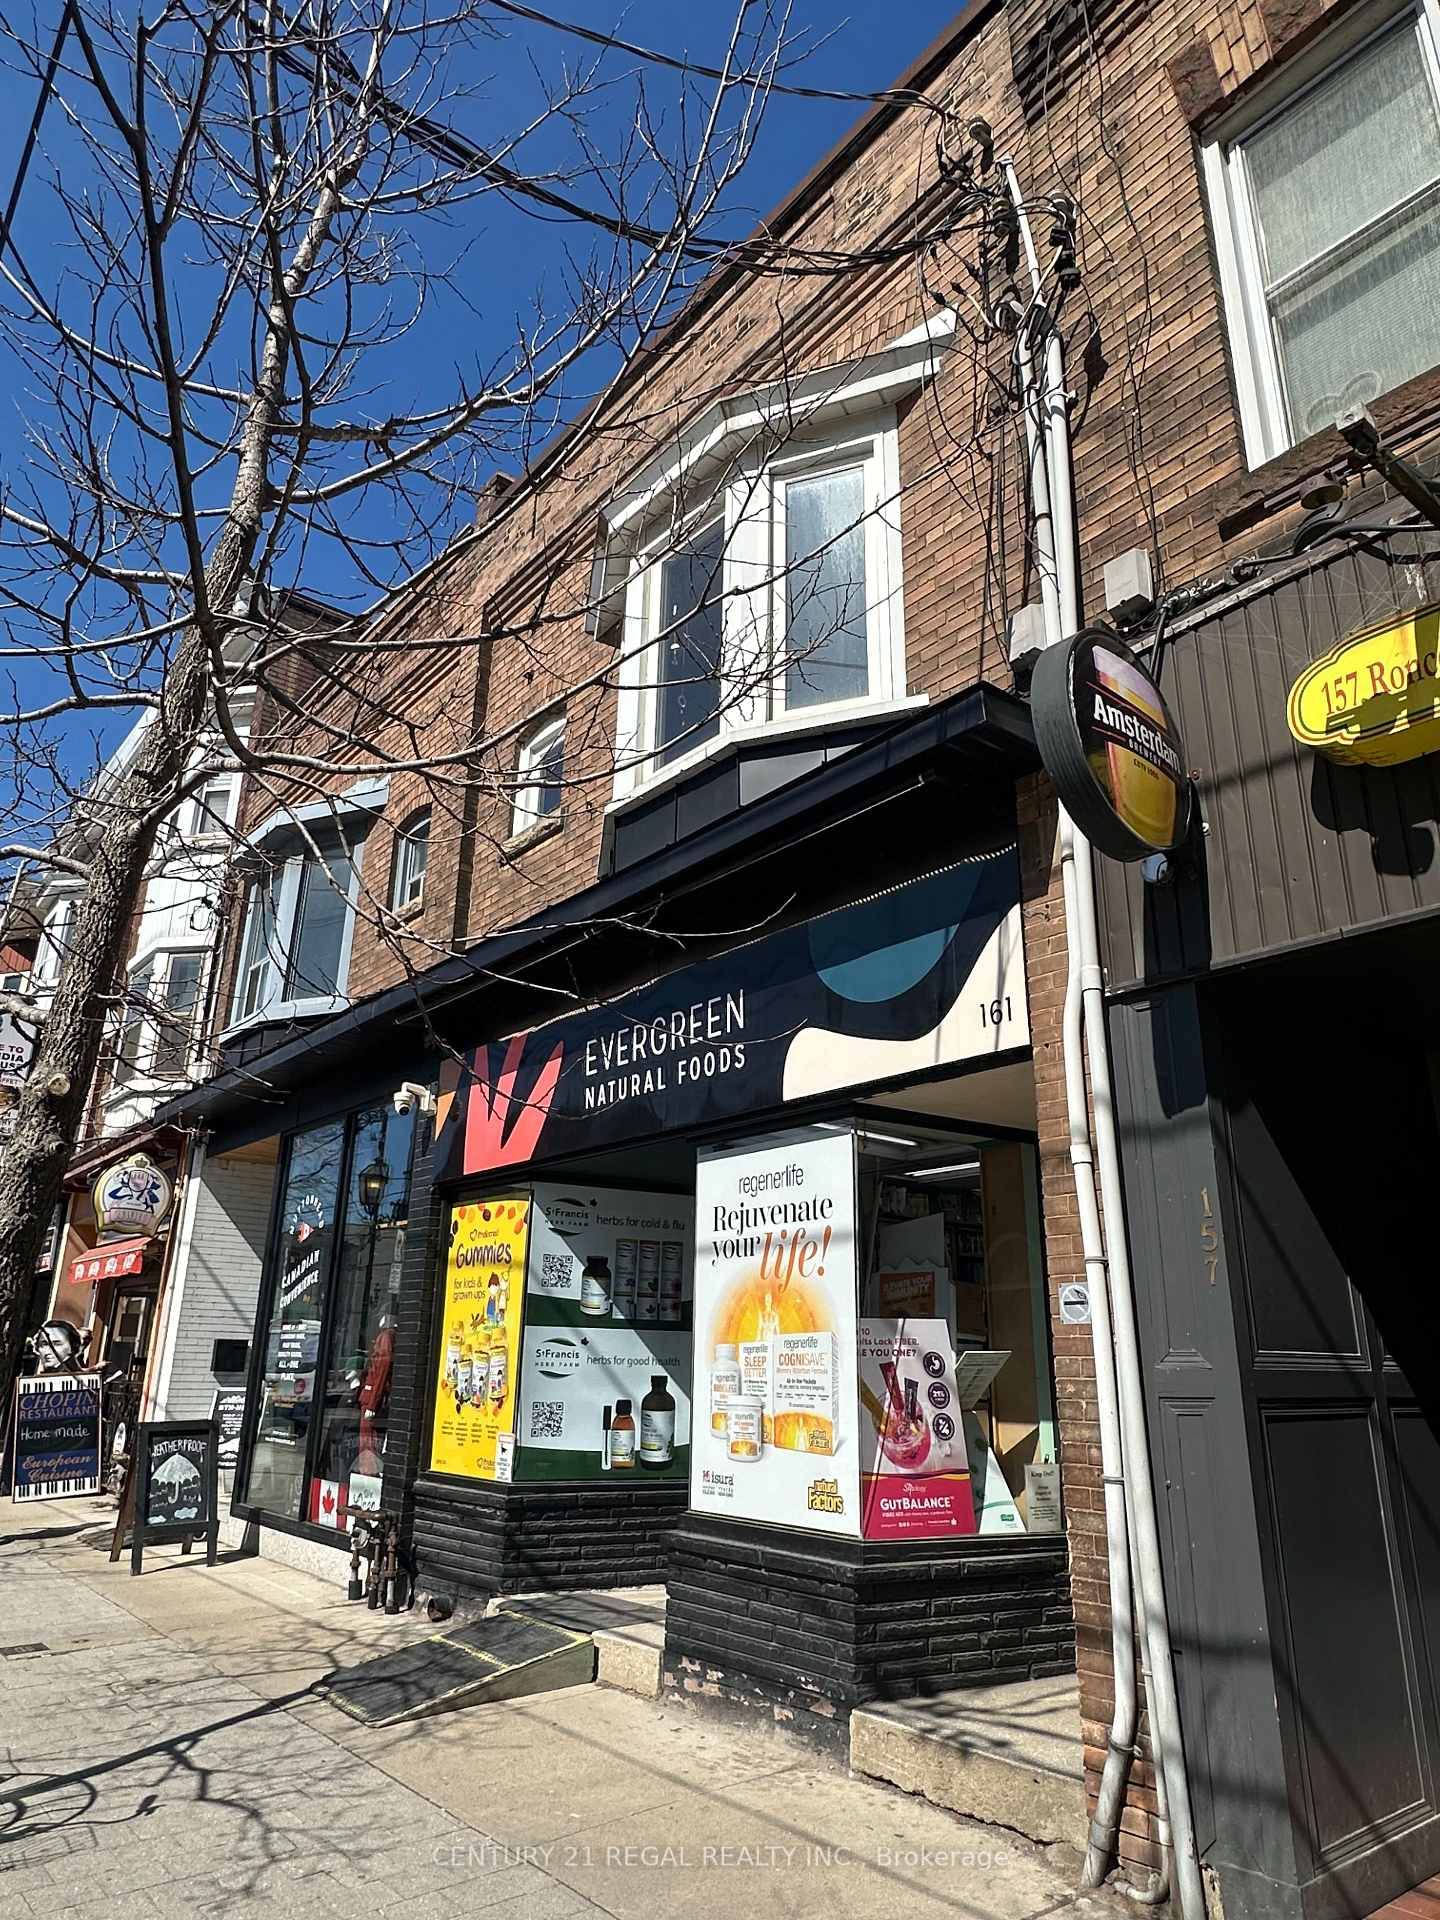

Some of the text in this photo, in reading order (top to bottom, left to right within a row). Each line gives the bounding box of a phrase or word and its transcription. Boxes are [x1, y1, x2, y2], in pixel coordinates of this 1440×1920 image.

[1321, 651, 1440, 715] 157 Ronc
[1093, 693, 1182, 775] Amsterdam
[978, 996, 1014, 1029] 161
[584, 988, 746, 1077] EVERGREEN
[0, 1052, 24, 1063] DIA
[8, 1045, 24, 1054] TO
[584, 1044, 747, 1110] NATURAL FOODS
[738, 1163, 804, 1198] regenerlife
[595, 1215, 624, 1227] herbs
[626, 1215, 640, 1227] for
[640, 1217, 661, 1229] cold
[662, 1219, 671, 1229] &
[672, 1220, 685, 1231] flu
[712, 1194, 834, 1237] Rejuvenate
[1200, 1187, 1218, 1287] 157
[455, 1242, 513, 1270] Gummies
[711, 1235, 761, 1267] your
[759, 1224, 833, 1294] life!
[281, 1249, 321, 1289] CANADIAN
[453, 1278, 463, 1289] for
[861, 1327, 871, 1336] 10
[586, 1354, 612, 1366] herbs
[613, 1355, 626, 1366] for
[627, 1356, 650, 1368] good
[651, 1356, 681, 1367] health
[744, 1356, 767, 1368] SLEEP
[869, 1349, 890, 1357] YOU
[891, 1349, 917, 1357] ONE?
[20, 1404, 97, 1420] RESTAURANT
[20, 1424, 91, 1441] Home made
[22, 1454, 94, 1472] European
[27, 1468, 87, 1483] Cuisine
[807, 1486, 845, 1514] Factors
